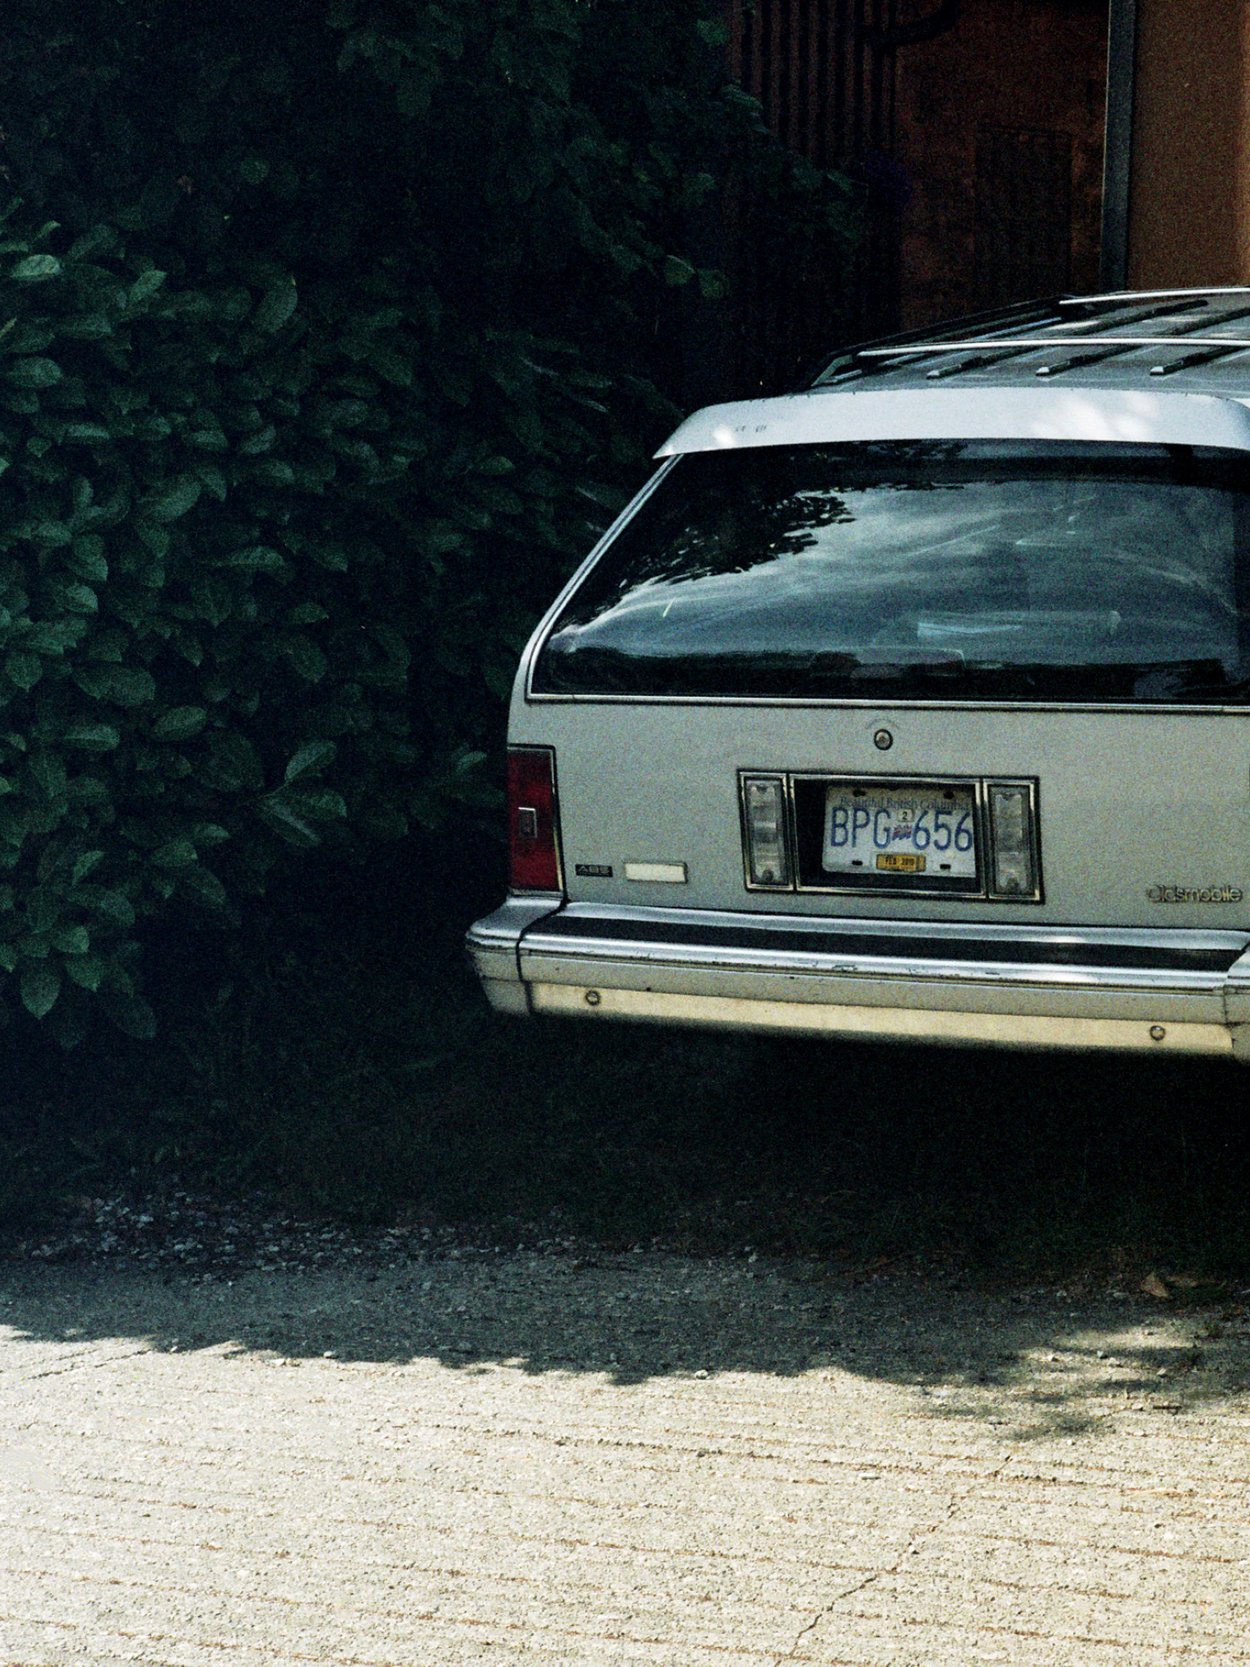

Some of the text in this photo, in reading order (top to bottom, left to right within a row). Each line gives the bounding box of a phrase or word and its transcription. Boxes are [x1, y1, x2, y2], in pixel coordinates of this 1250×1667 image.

[886, 797, 917, 809] British
[830, 806, 974, 852] BPG 656
[1147, 883, 1244, 903] Oldsmobile
